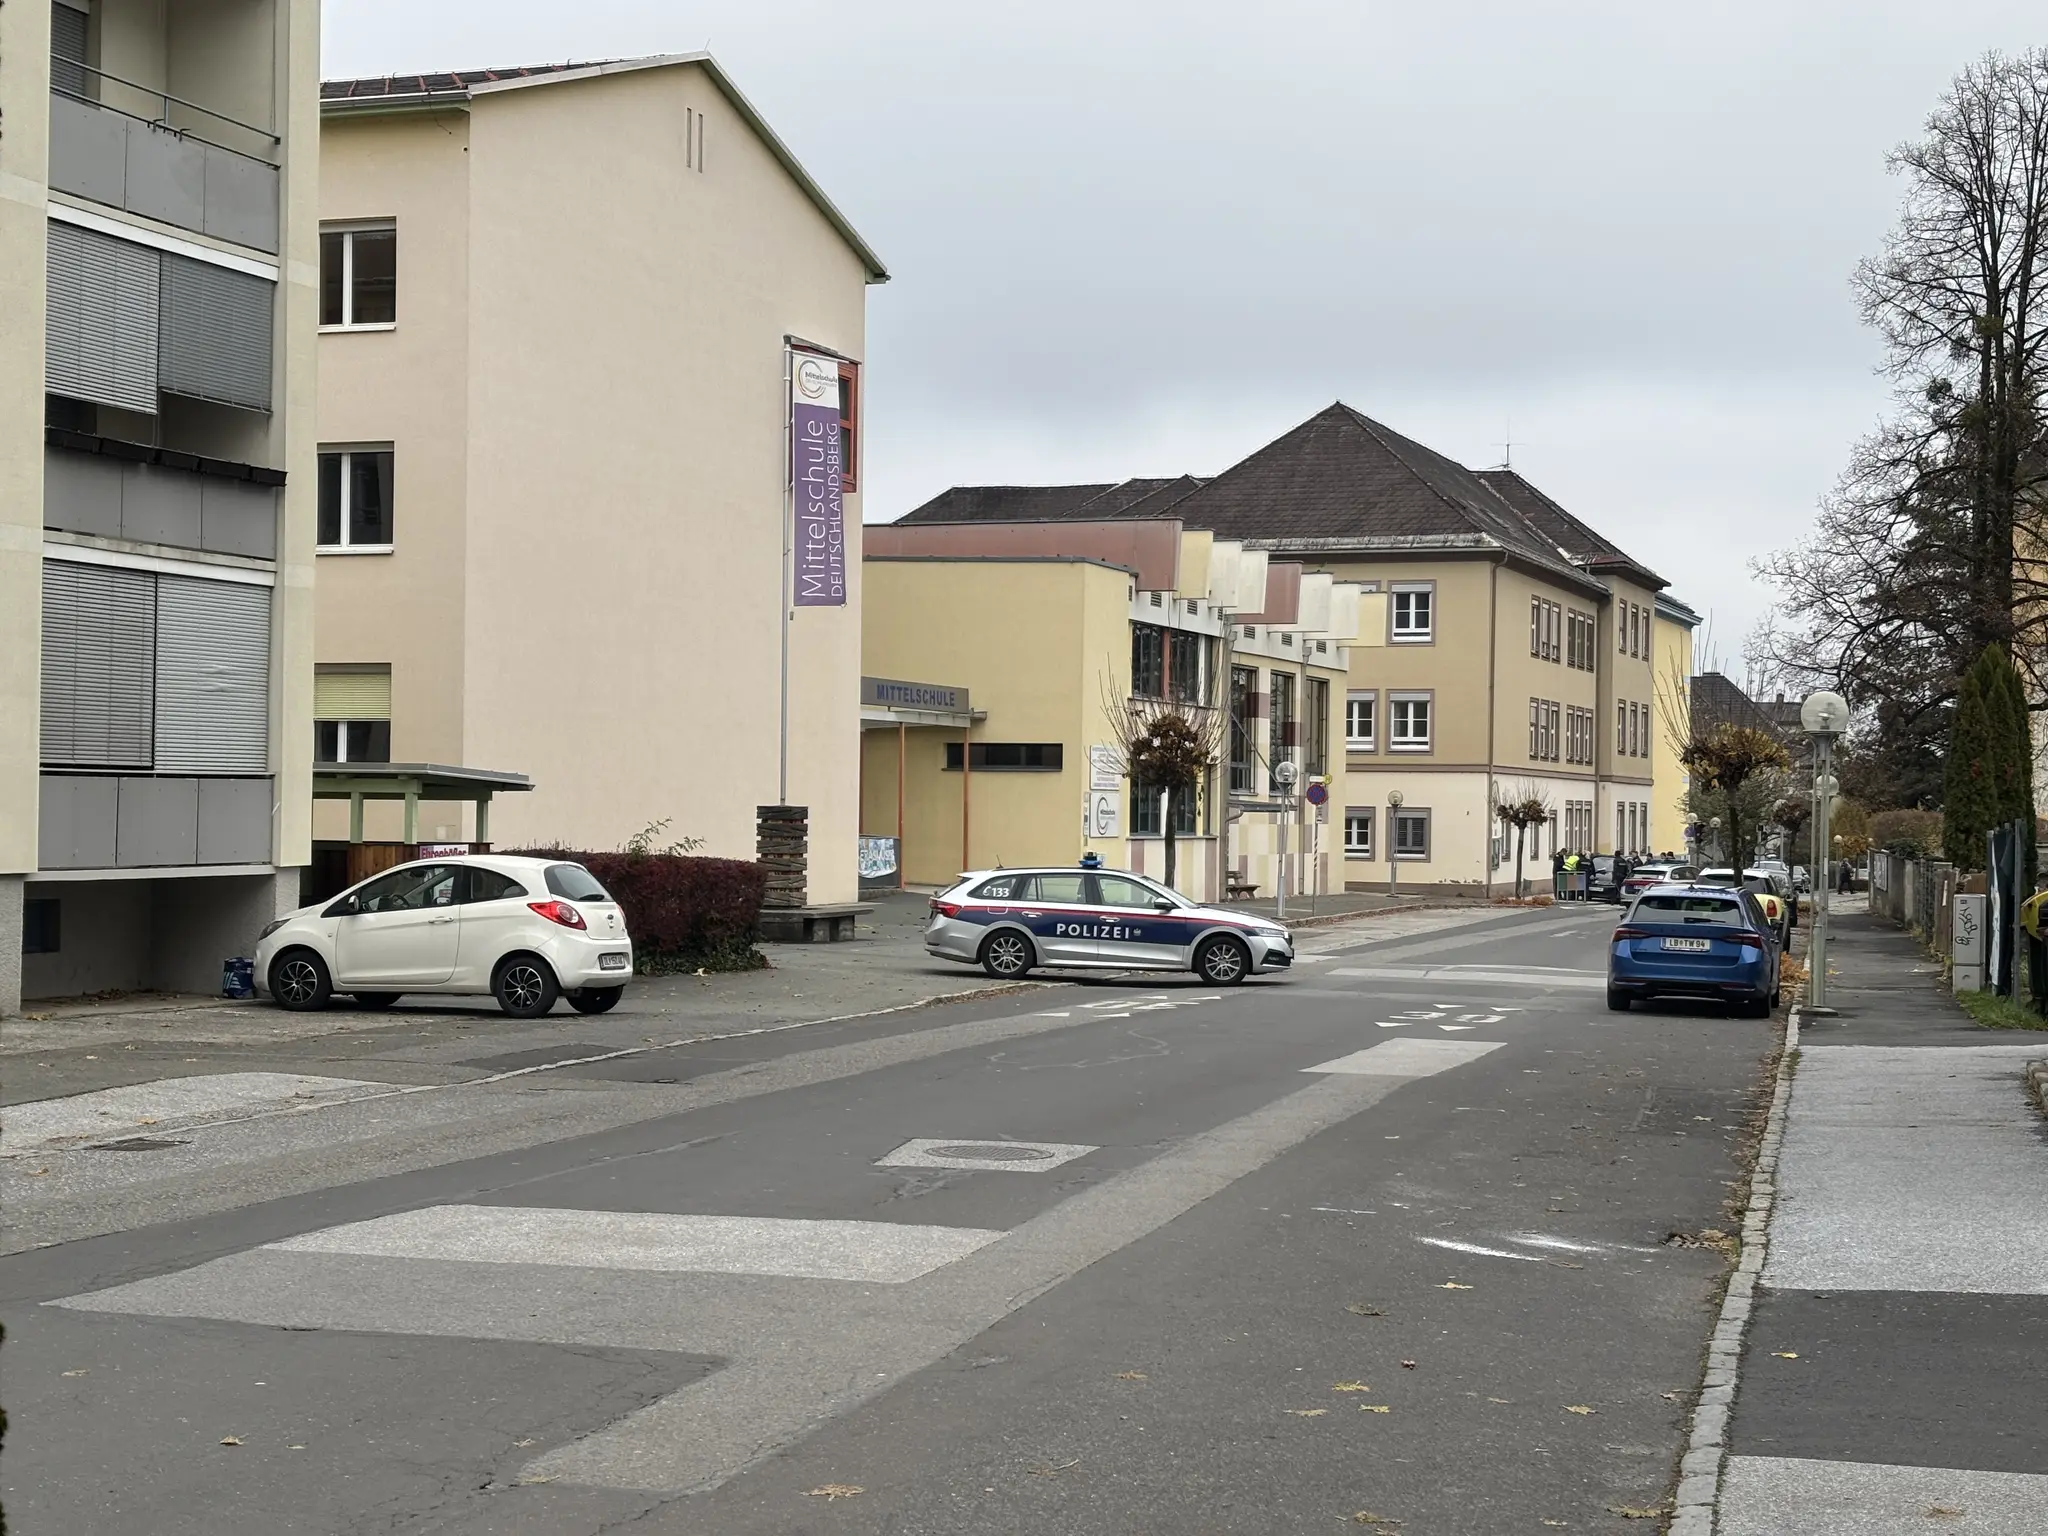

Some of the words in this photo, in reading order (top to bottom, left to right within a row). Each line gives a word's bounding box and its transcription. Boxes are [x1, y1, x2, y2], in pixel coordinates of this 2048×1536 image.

[801, 420, 826, 597] Mittelschule
[826, 423, 843, 597] DEUTSCHLANDSBERG
[876, 684, 955, 707] MITTELSCHULE
[991, 887, 1010, 898] 133
[1056, 923, 1130, 939] POLIZEI
